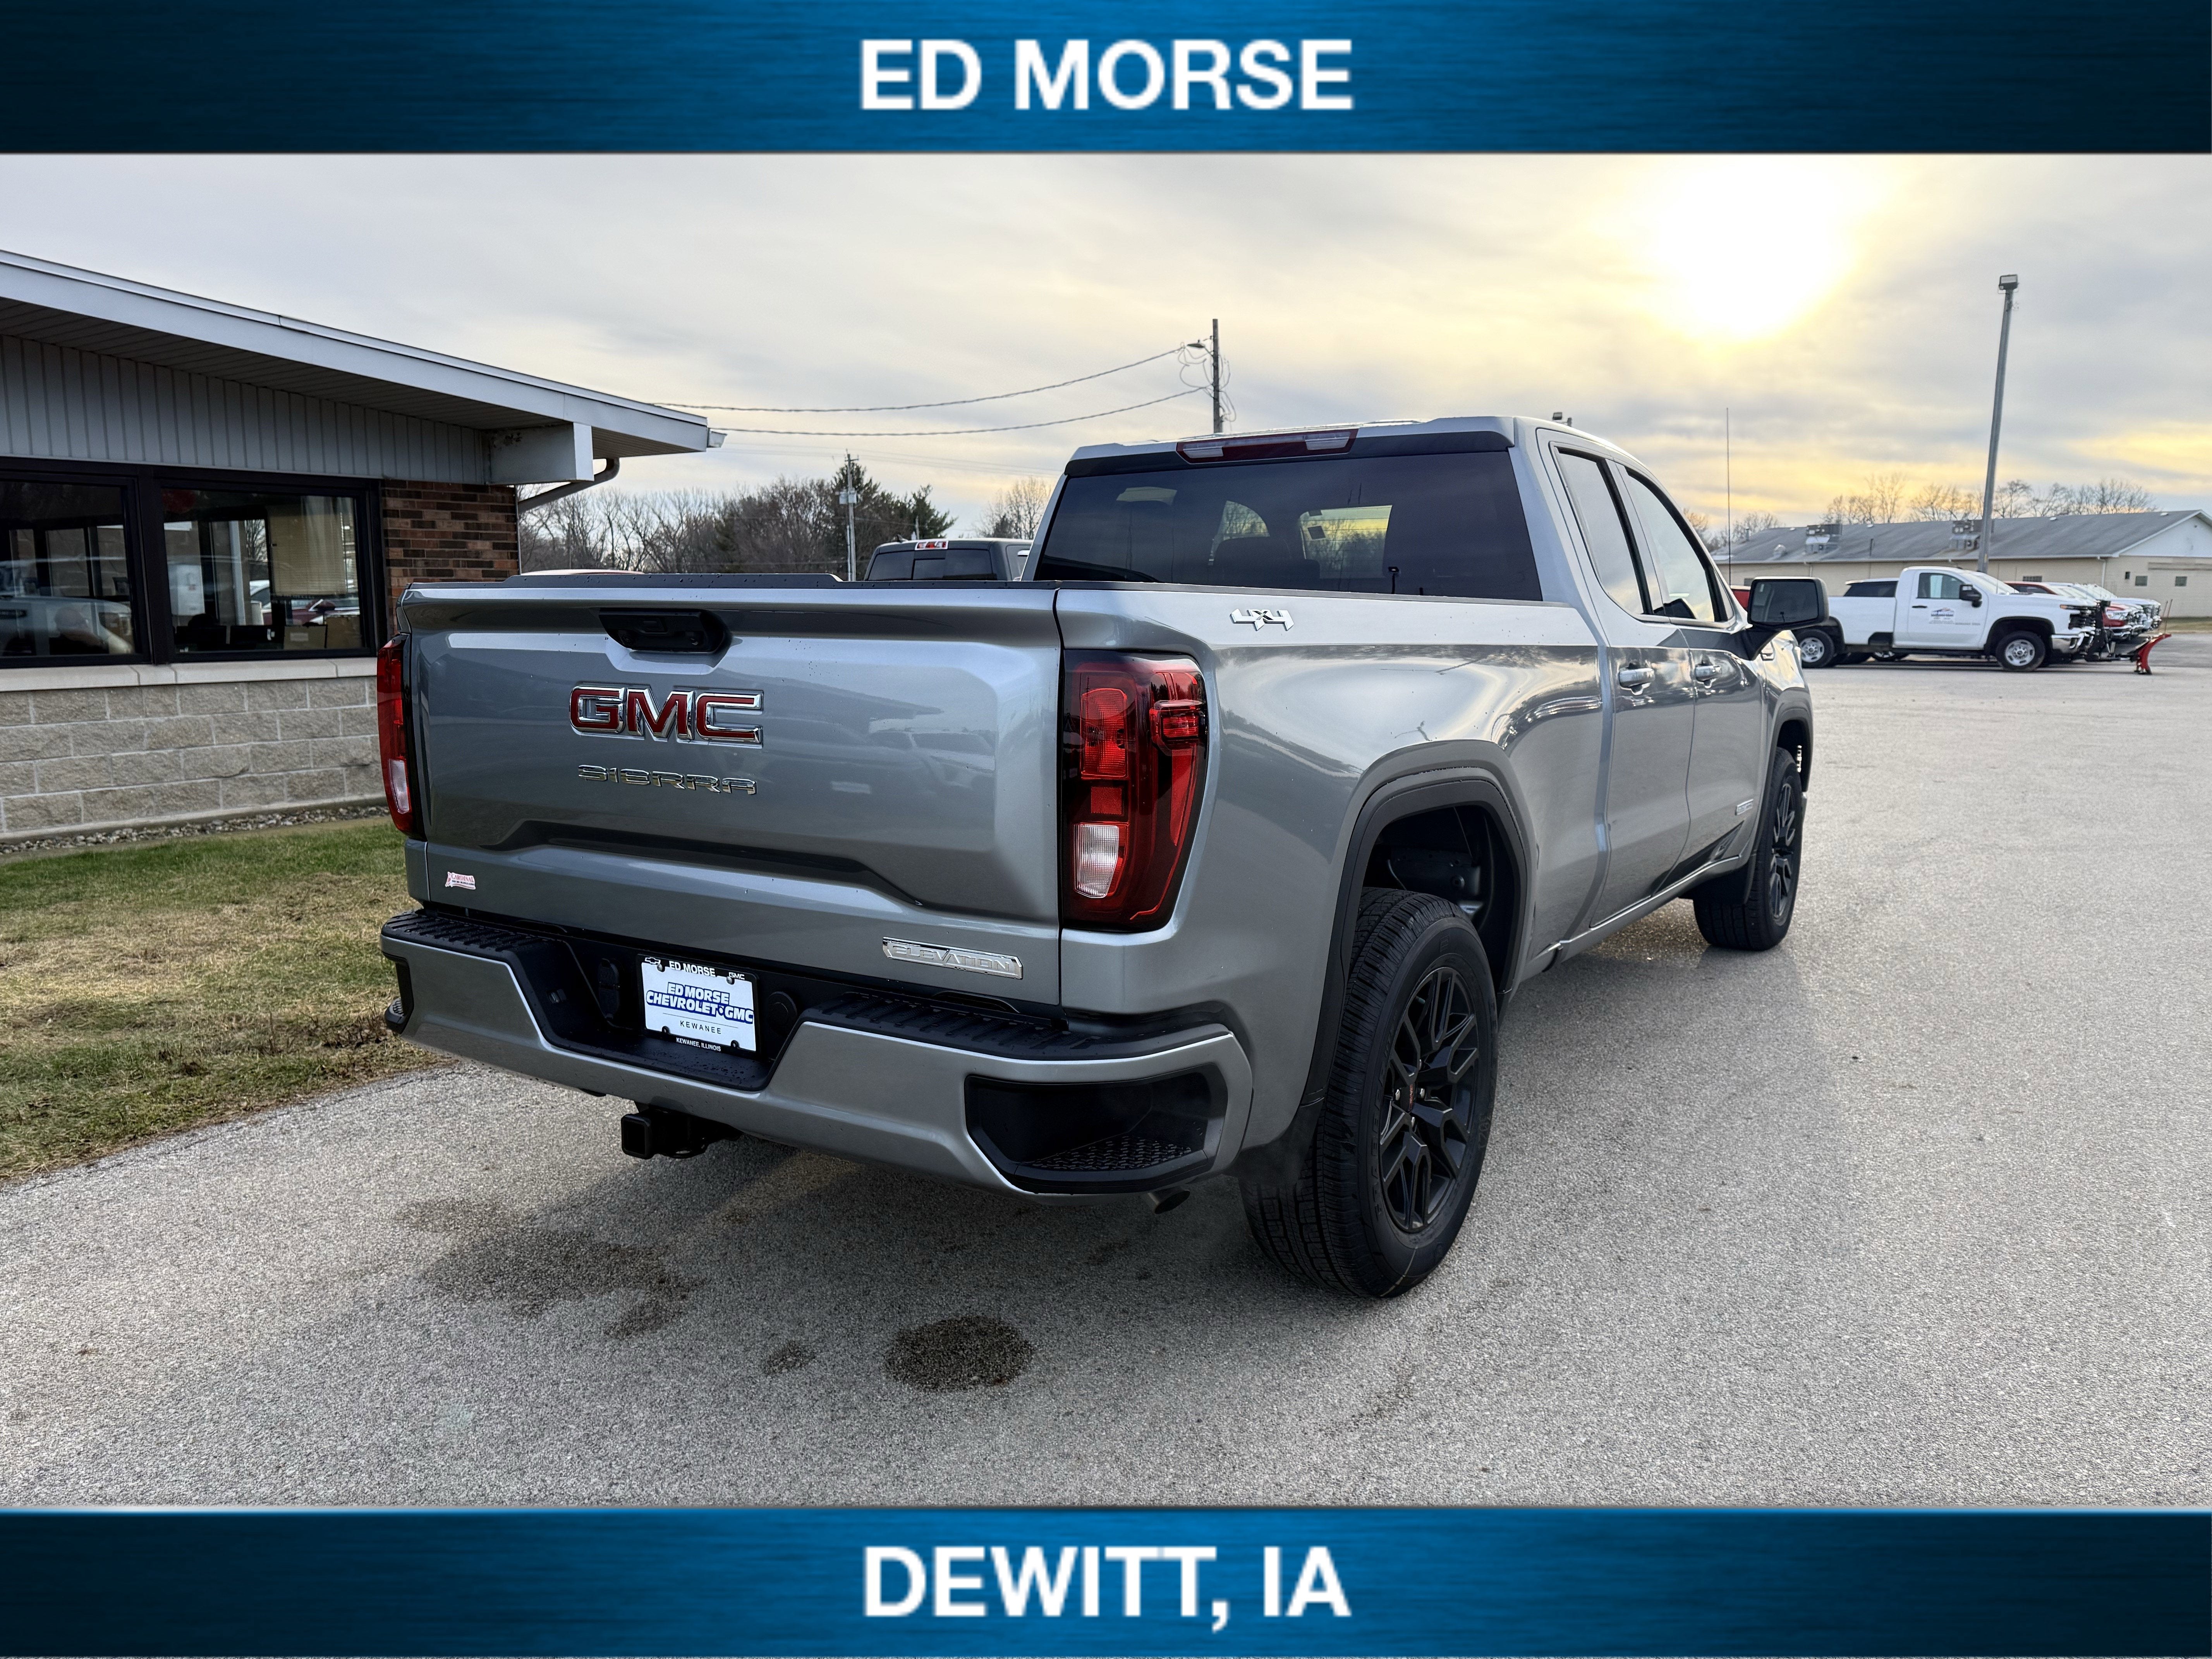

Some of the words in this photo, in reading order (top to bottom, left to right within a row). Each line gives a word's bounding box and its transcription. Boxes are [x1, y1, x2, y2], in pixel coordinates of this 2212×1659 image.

[570, 685, 764, 747] GMC
[578, 764, 757, 795] SIERRA
[451, 873, 474, 883] CARDINAL
[892, 945, 1010, 972] ELEVATION
[669, 960, 681, 971] ED
[683, 963, 716, 977] MORSE
[728, 972, 745, 980] GMC
[668, 983, 684, 996] ED
[685, 986, 730, 1005] MORSE
[680, 1020, 721, 1034] KEWANEE
[676, 1037, 700, 1048] KEWANEE,
[701, 1042, 721, 1051] ILLINOIS
